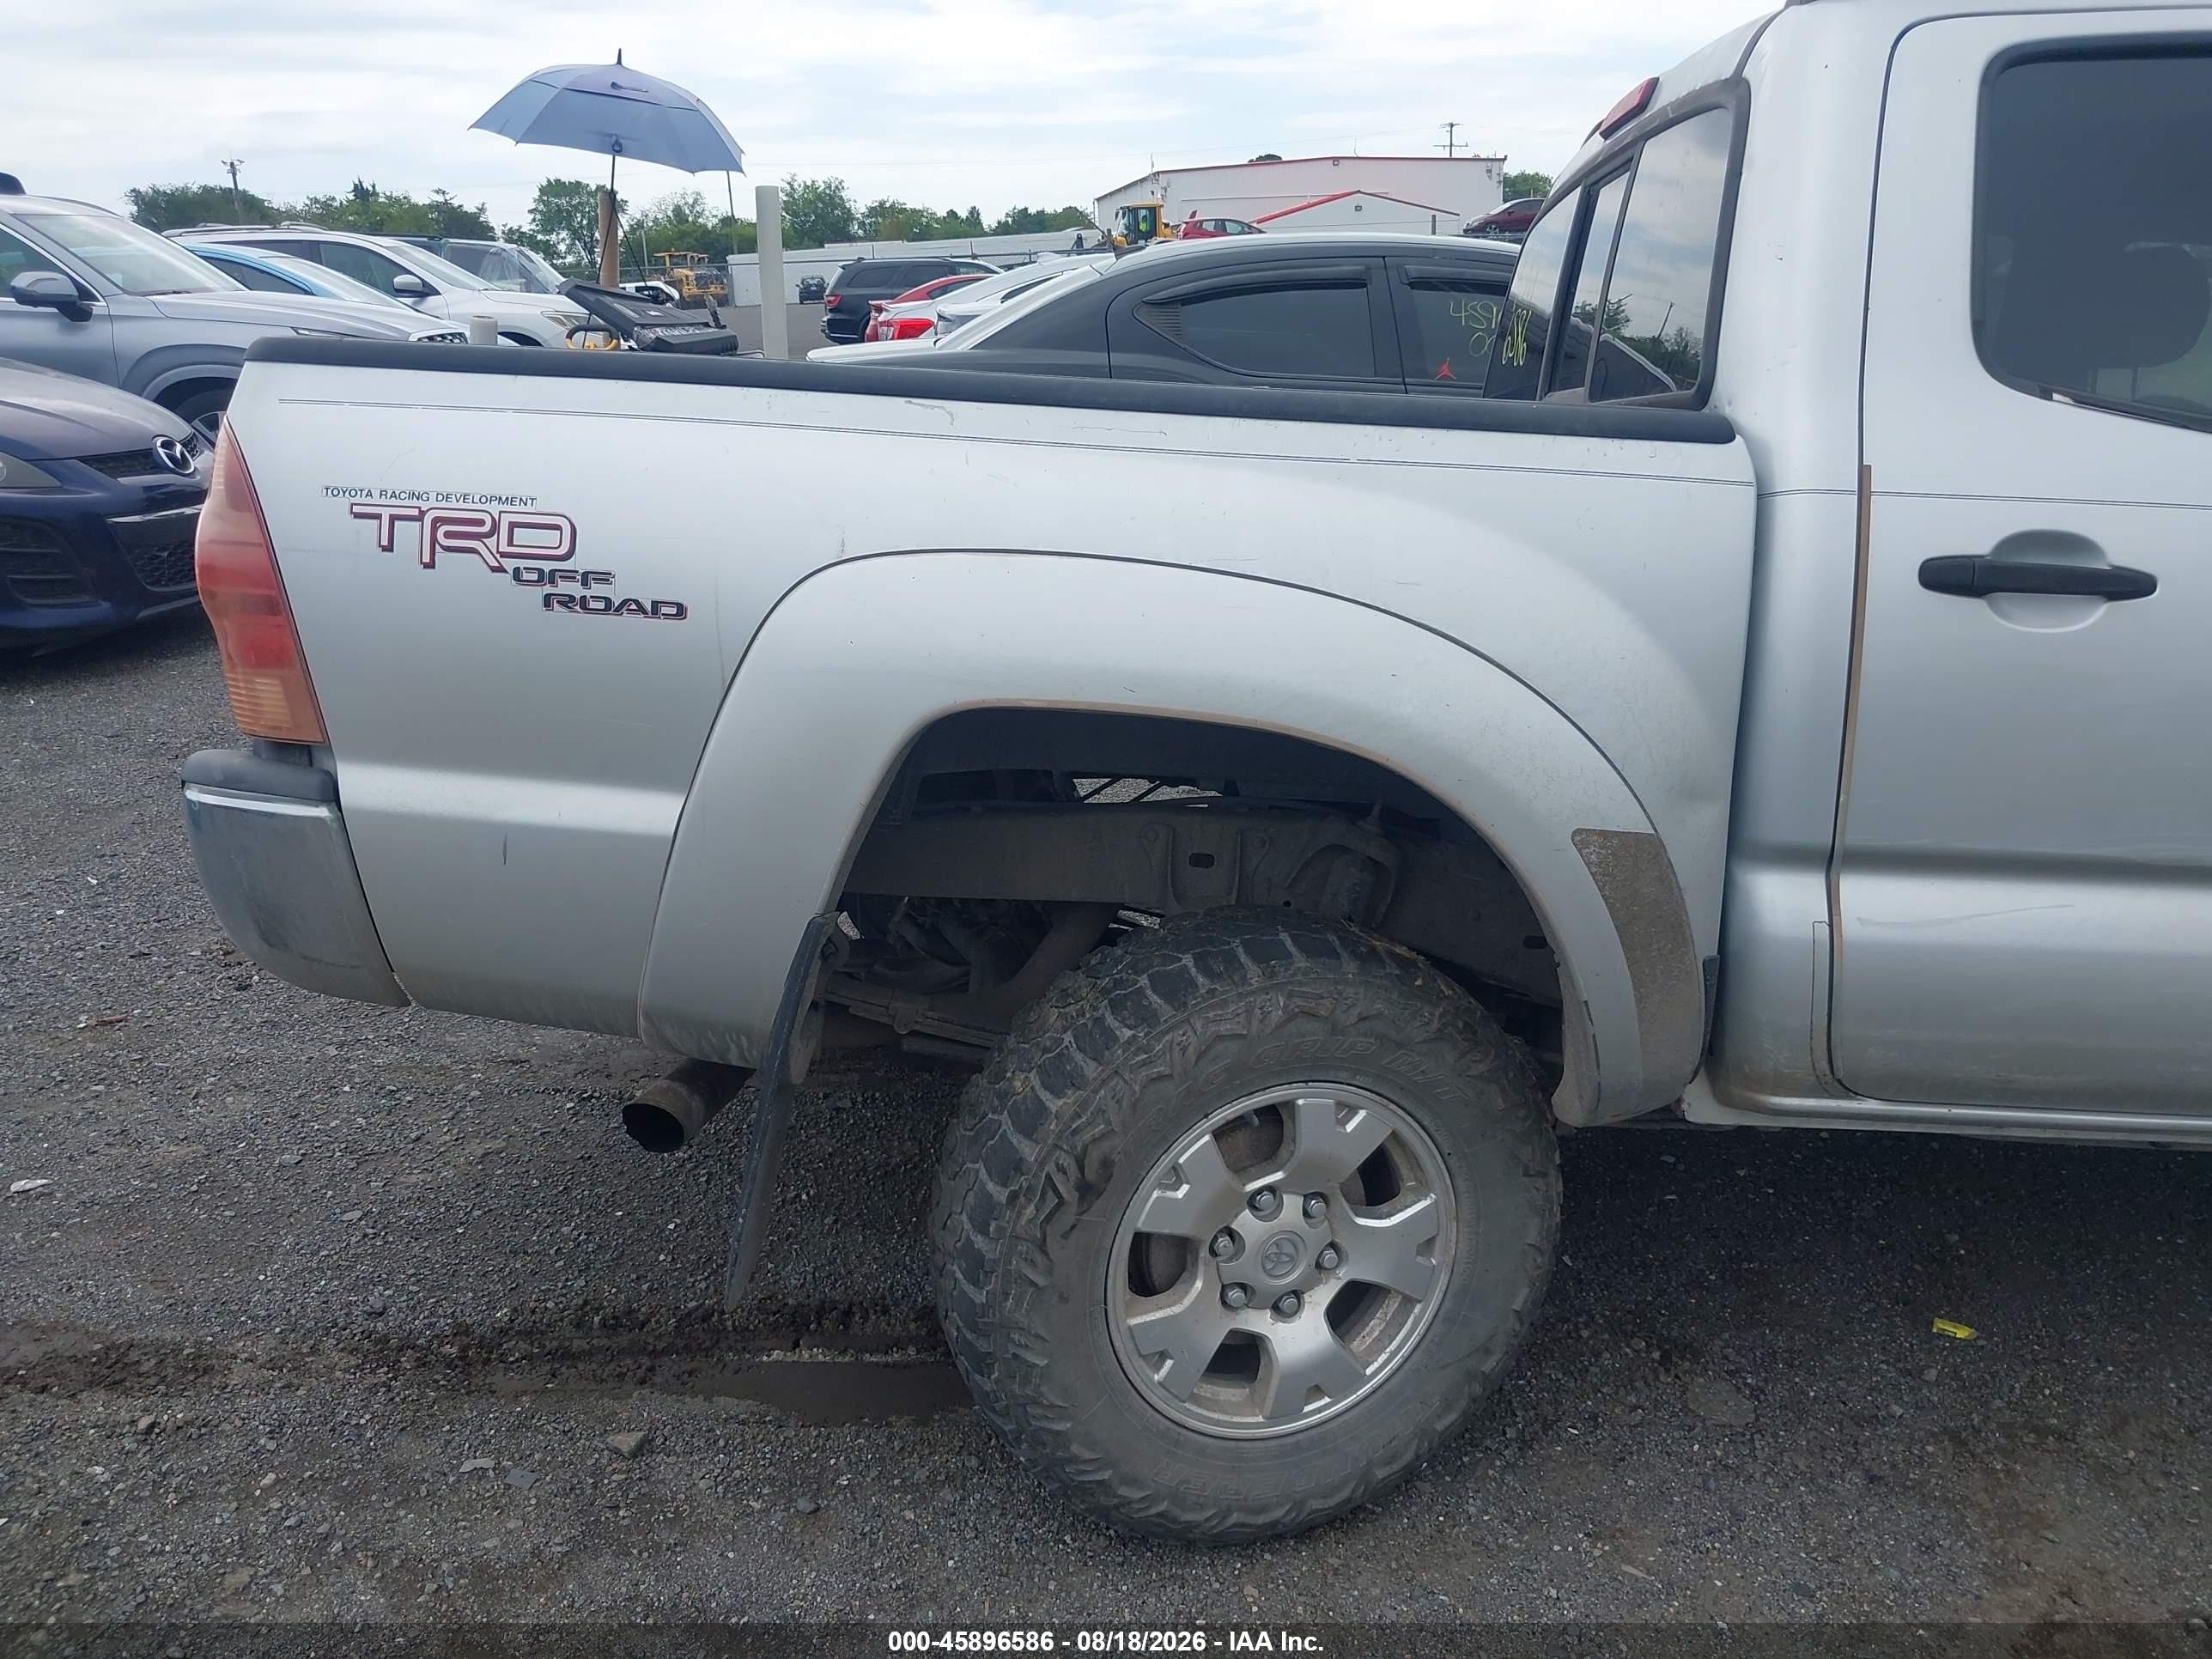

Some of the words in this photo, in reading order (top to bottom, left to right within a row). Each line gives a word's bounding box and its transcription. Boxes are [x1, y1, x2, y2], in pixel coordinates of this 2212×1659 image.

[324, 487, 374, 500] TOYOTA
[379, 489, 430, 502] RACING
[435, 493, 537, 507] DEVELOPMENT
[349, 502, 578, 574] TRD
[512, 566, 616, 589] OFF
[543, 592, 689, 621] ROAD
